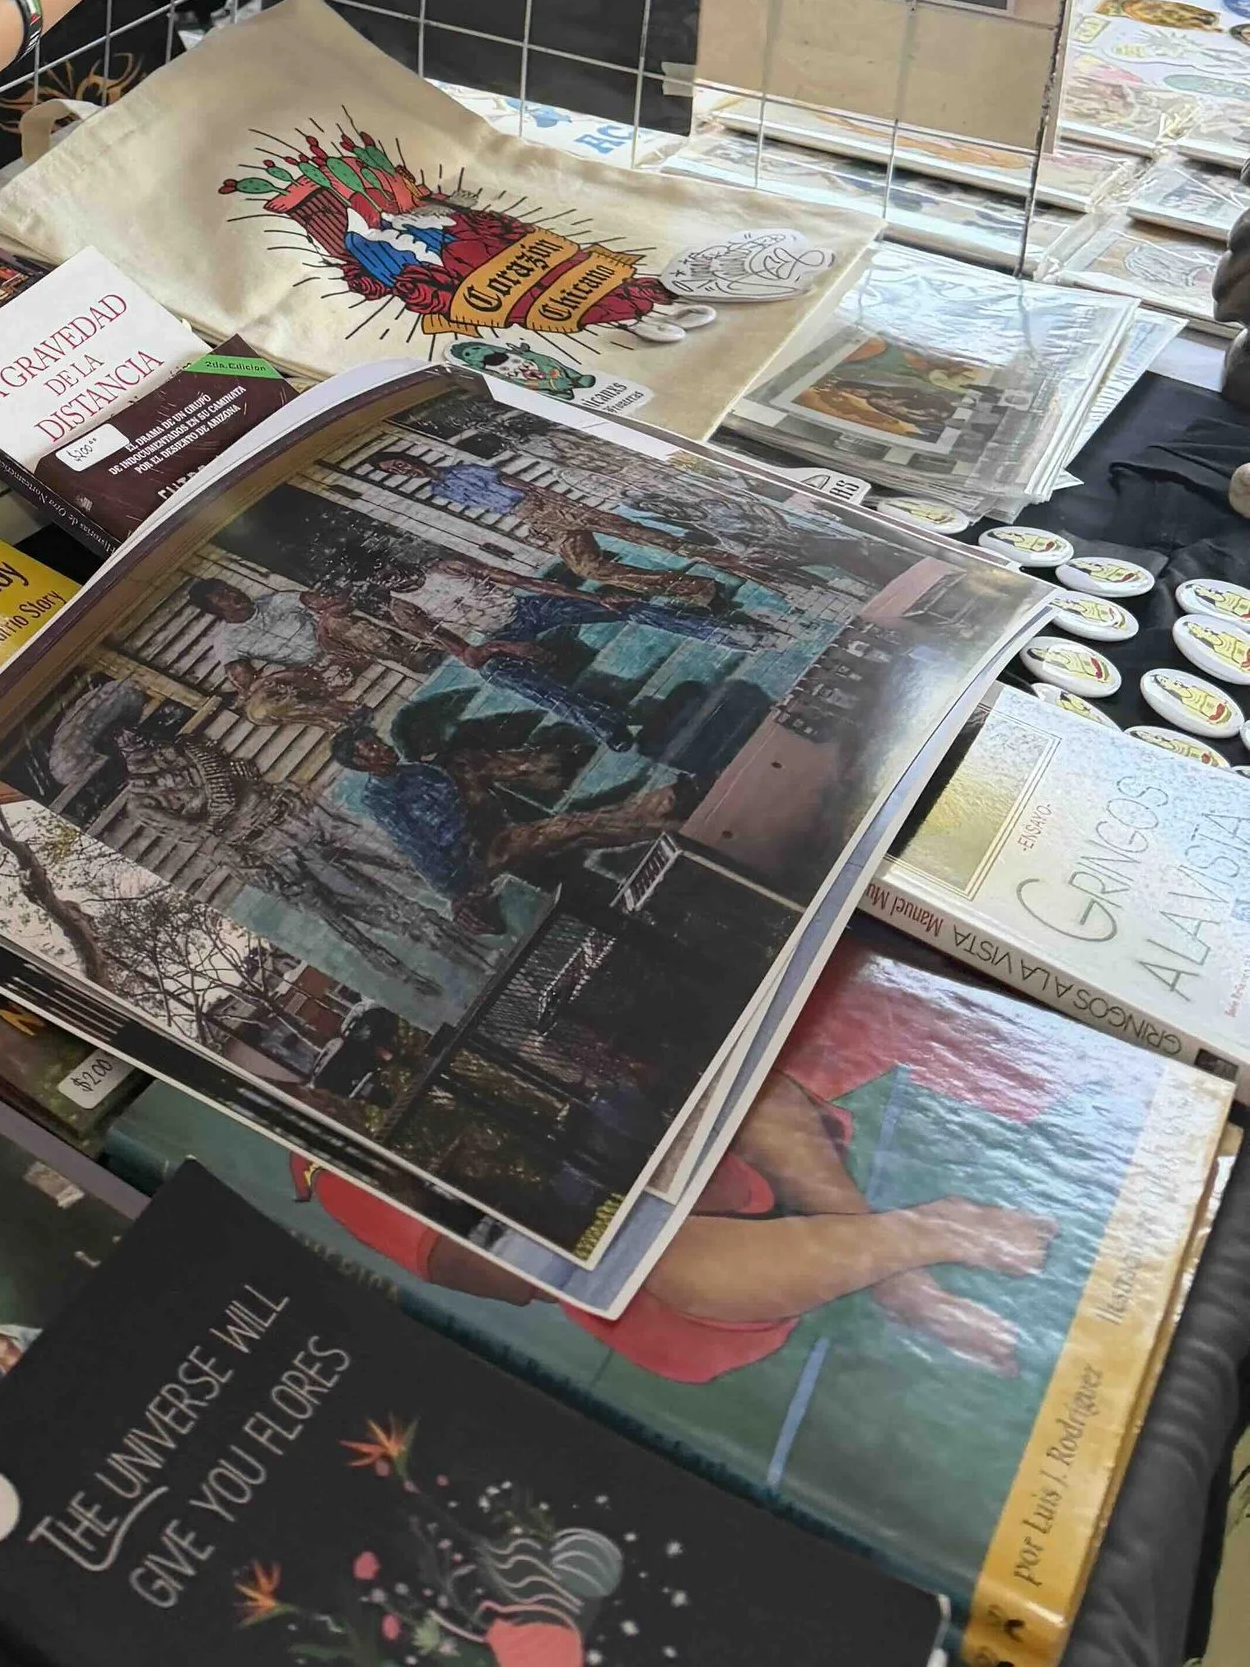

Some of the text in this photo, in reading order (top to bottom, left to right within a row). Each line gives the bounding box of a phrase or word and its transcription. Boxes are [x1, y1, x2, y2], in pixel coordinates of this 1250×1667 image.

[538, 264, 617, 322] Chicano
[0, 292, 129, 390] GRAVEDAD
[43, 352, 106, 398] DE LA
[33, 348, 166, 444] DISTANCIA
[108, 385, 247, 476] DE INDOCUMENTADOS EN SU CAMINATA
[126, 392, 213, 453] EL DRAMA DE UN GRUPO
[134, 404, 242, 474] POR EL DESIERTO DE ARIZONA
[48, 499, 68, 519] Otra
[67, 514, 80, 526] de
[20, 589, 67, 621] Story
[1015, 775, 1169, 944] GRINGOS
[890, 893, 947, 938] Manuel
[1134, 809, 1250, 1003] A LA VISTA
[951, 923, 1184, 1056] GRINGOS A LA VISTA
[27, 1492, 120, 1556] THE
[94, 1345, 236, 1502] UNIVERSE
[209, 1283, 291, 1355] WILL
[128, 1519, 216, 1610] GIVE
[189, 1445, 269, 1524] YOU
[242, 1334, 353, 1457] FLORES
[1010, 1534, 1047, 1587] por
[1032, 1477, 1066, 1540] Luis
